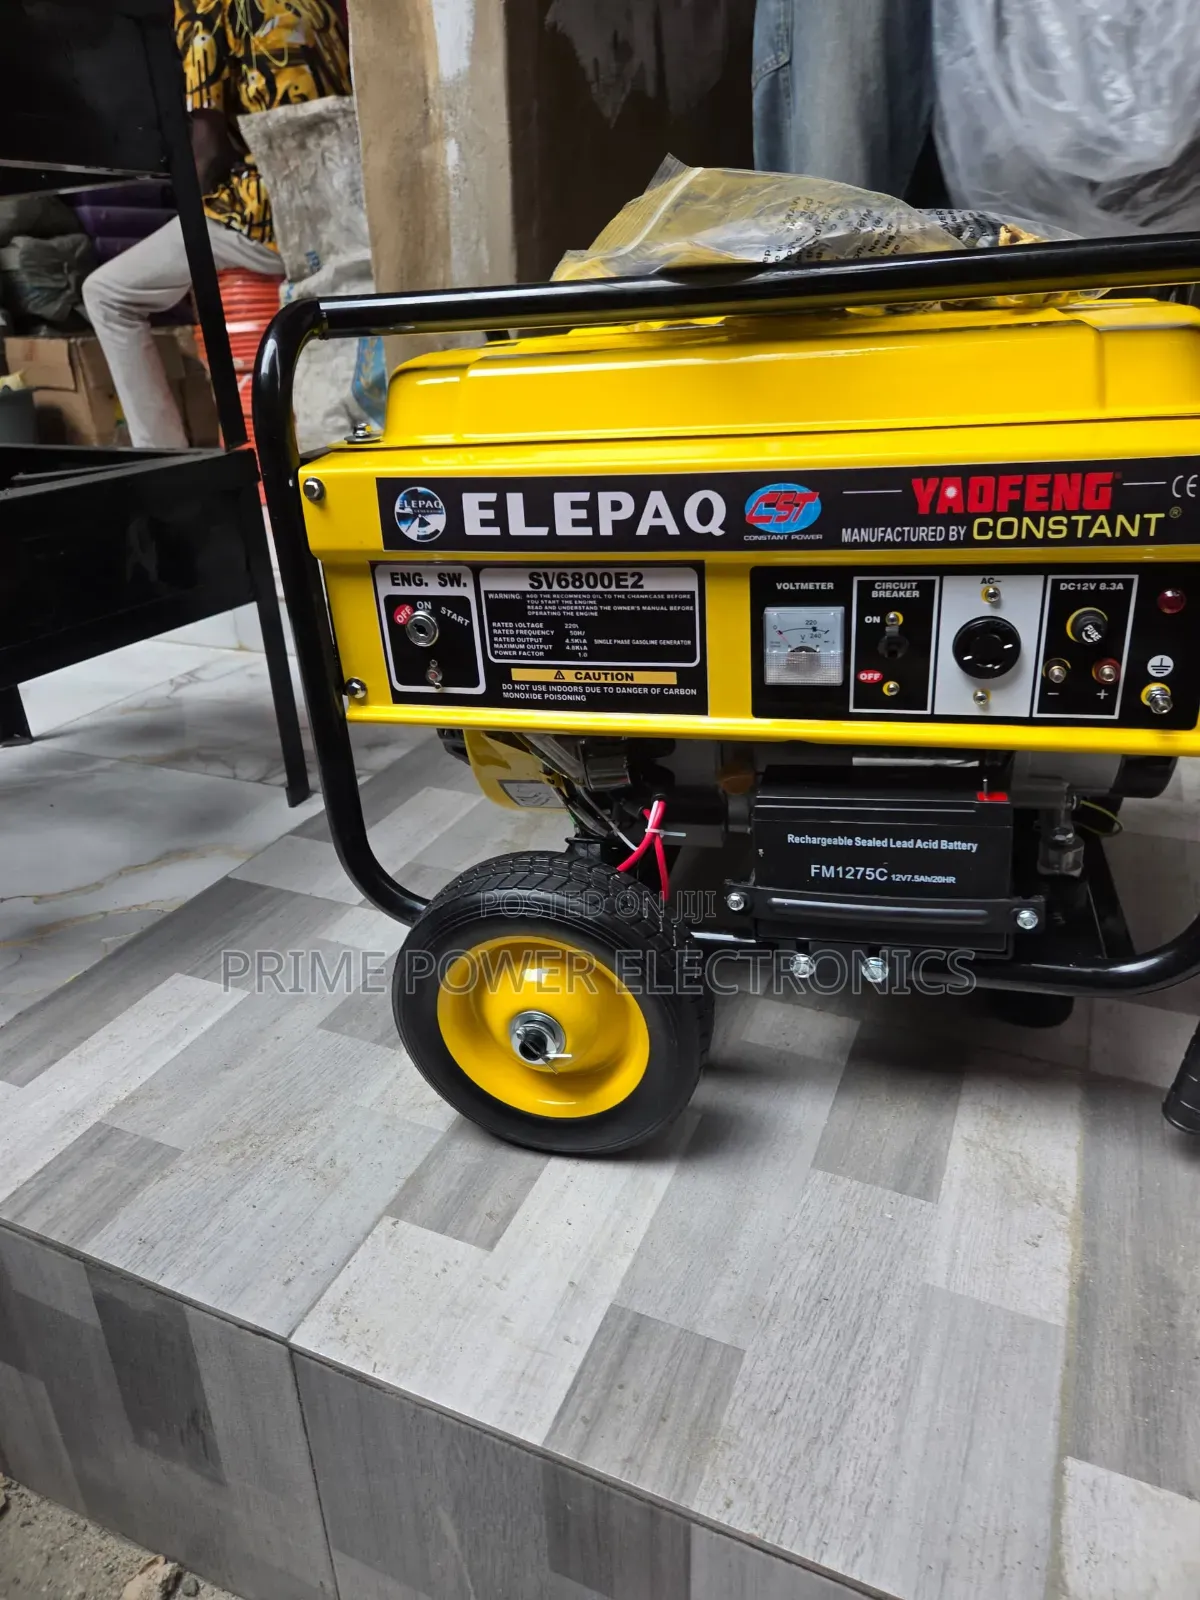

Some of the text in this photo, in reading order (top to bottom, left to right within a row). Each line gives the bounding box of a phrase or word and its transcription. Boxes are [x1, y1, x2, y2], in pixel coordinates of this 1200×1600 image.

[911, 472, 1113, 515] YAOFENG
[461, 489, 727, 537] ELEPAQ
[841, 513, 1166, 543] MANUFACTURED BY CONSTANT
[389, 572, 468, 588] ENG. SW.
[528, 571, 645, 590] SV6800E2
[775, 582, 835, 590] VOLTMETER
[874, 582, 918, 590] CIRCUIT
[1059, 582, 1125, 590] DC12V 8.3A
[871, 590, 920, 598] BREAKER
[416, 601, 432, 610] ON
[396, 605, 412, 624] OFF
[440, 606, 471, 627] START
[864, 615, 881, 624] ON
[516, 629, 555, 637] FREQUENCY
[1083, 624, 1102, 642] FUSE
[574, 671, 635, 682] CAUTION
[859, 671, 881, 681] OFF
[532, 684, 547, 692] USE
[549, 685, 584, 693] INDOORS
[585, 686, 601, 694] DUE
[616, 687, 649, 695] DANGER
[650, 687, 661, 695] OF
[663, 687, 697, 696] CARBON
[502, 692, 587, 702] MONOXIDE POISONING
[787, 833, 978, 852] Rechargeable Sealed Lead Acid Battery
[810, 864, 888, 881] FM1275C
